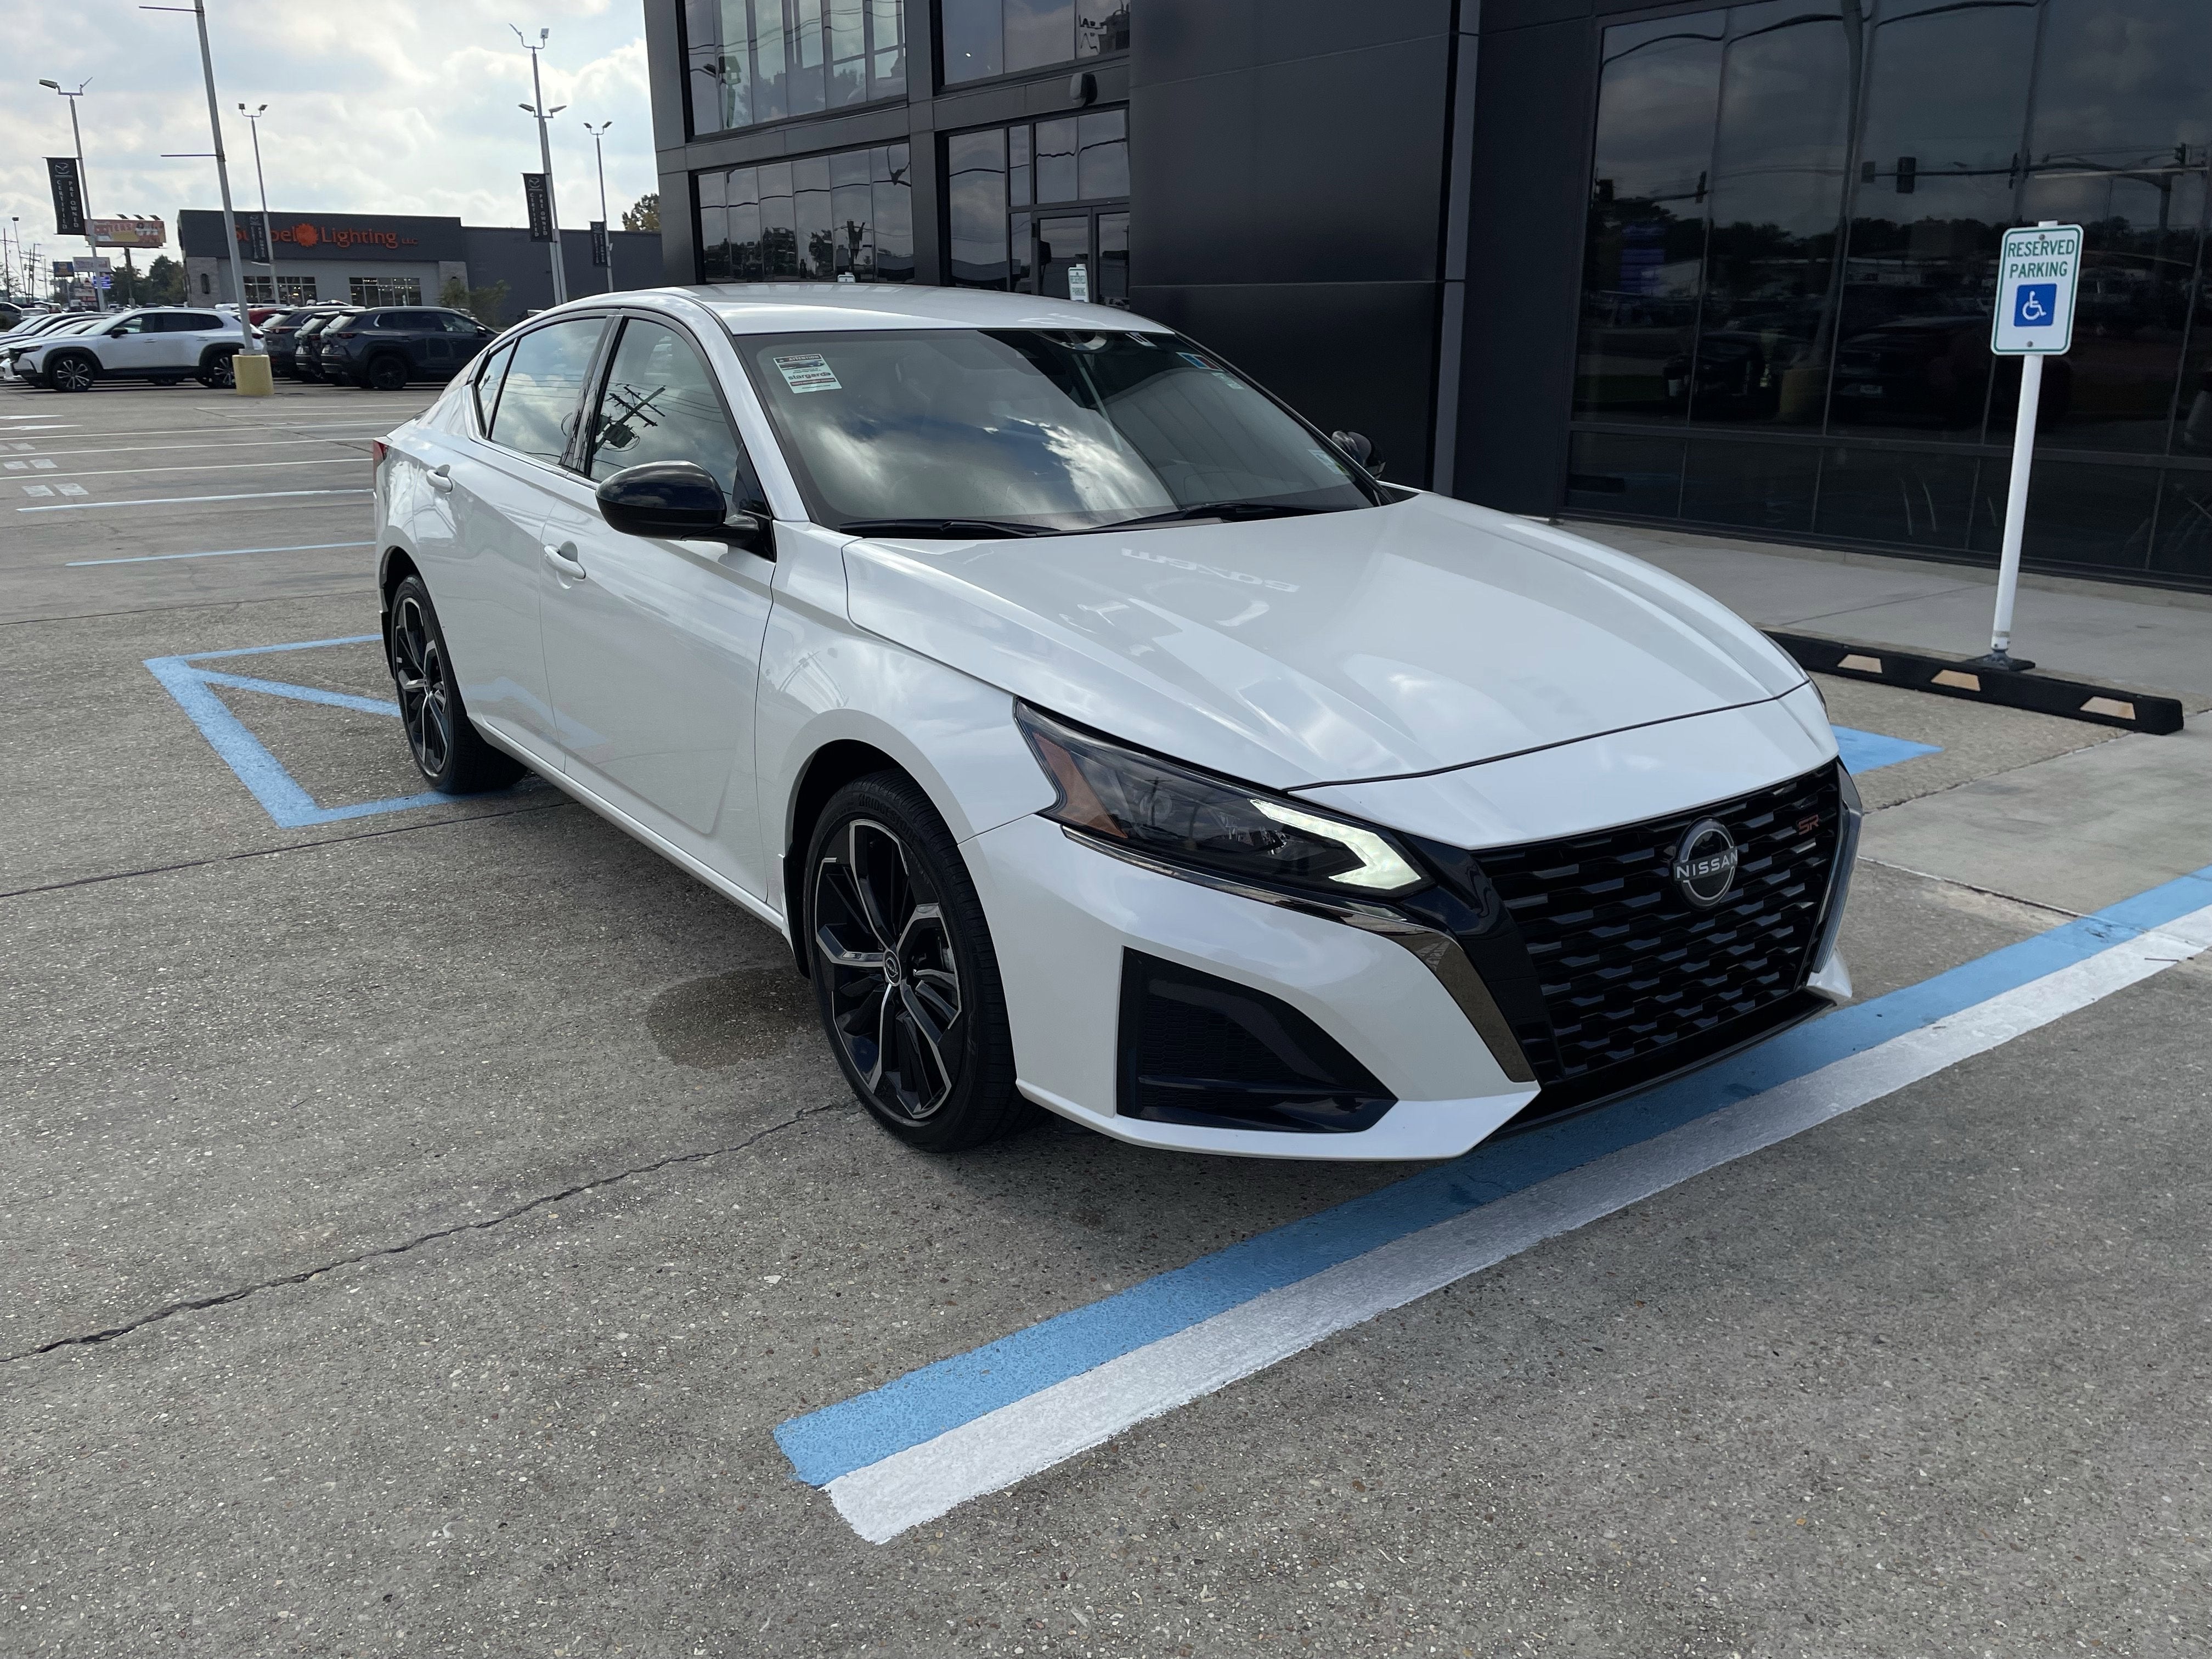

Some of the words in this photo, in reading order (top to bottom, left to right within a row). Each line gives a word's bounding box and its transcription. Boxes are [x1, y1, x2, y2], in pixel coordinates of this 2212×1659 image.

[320, 226, 399, 249] Lighting
[2007, 239, 2075, 257] RESERVED
[2009, 261, 2068, 279] PARKING
[1798, 814, 1819, 836] SR
[1676, 849, 1738, 879] NISSAN
